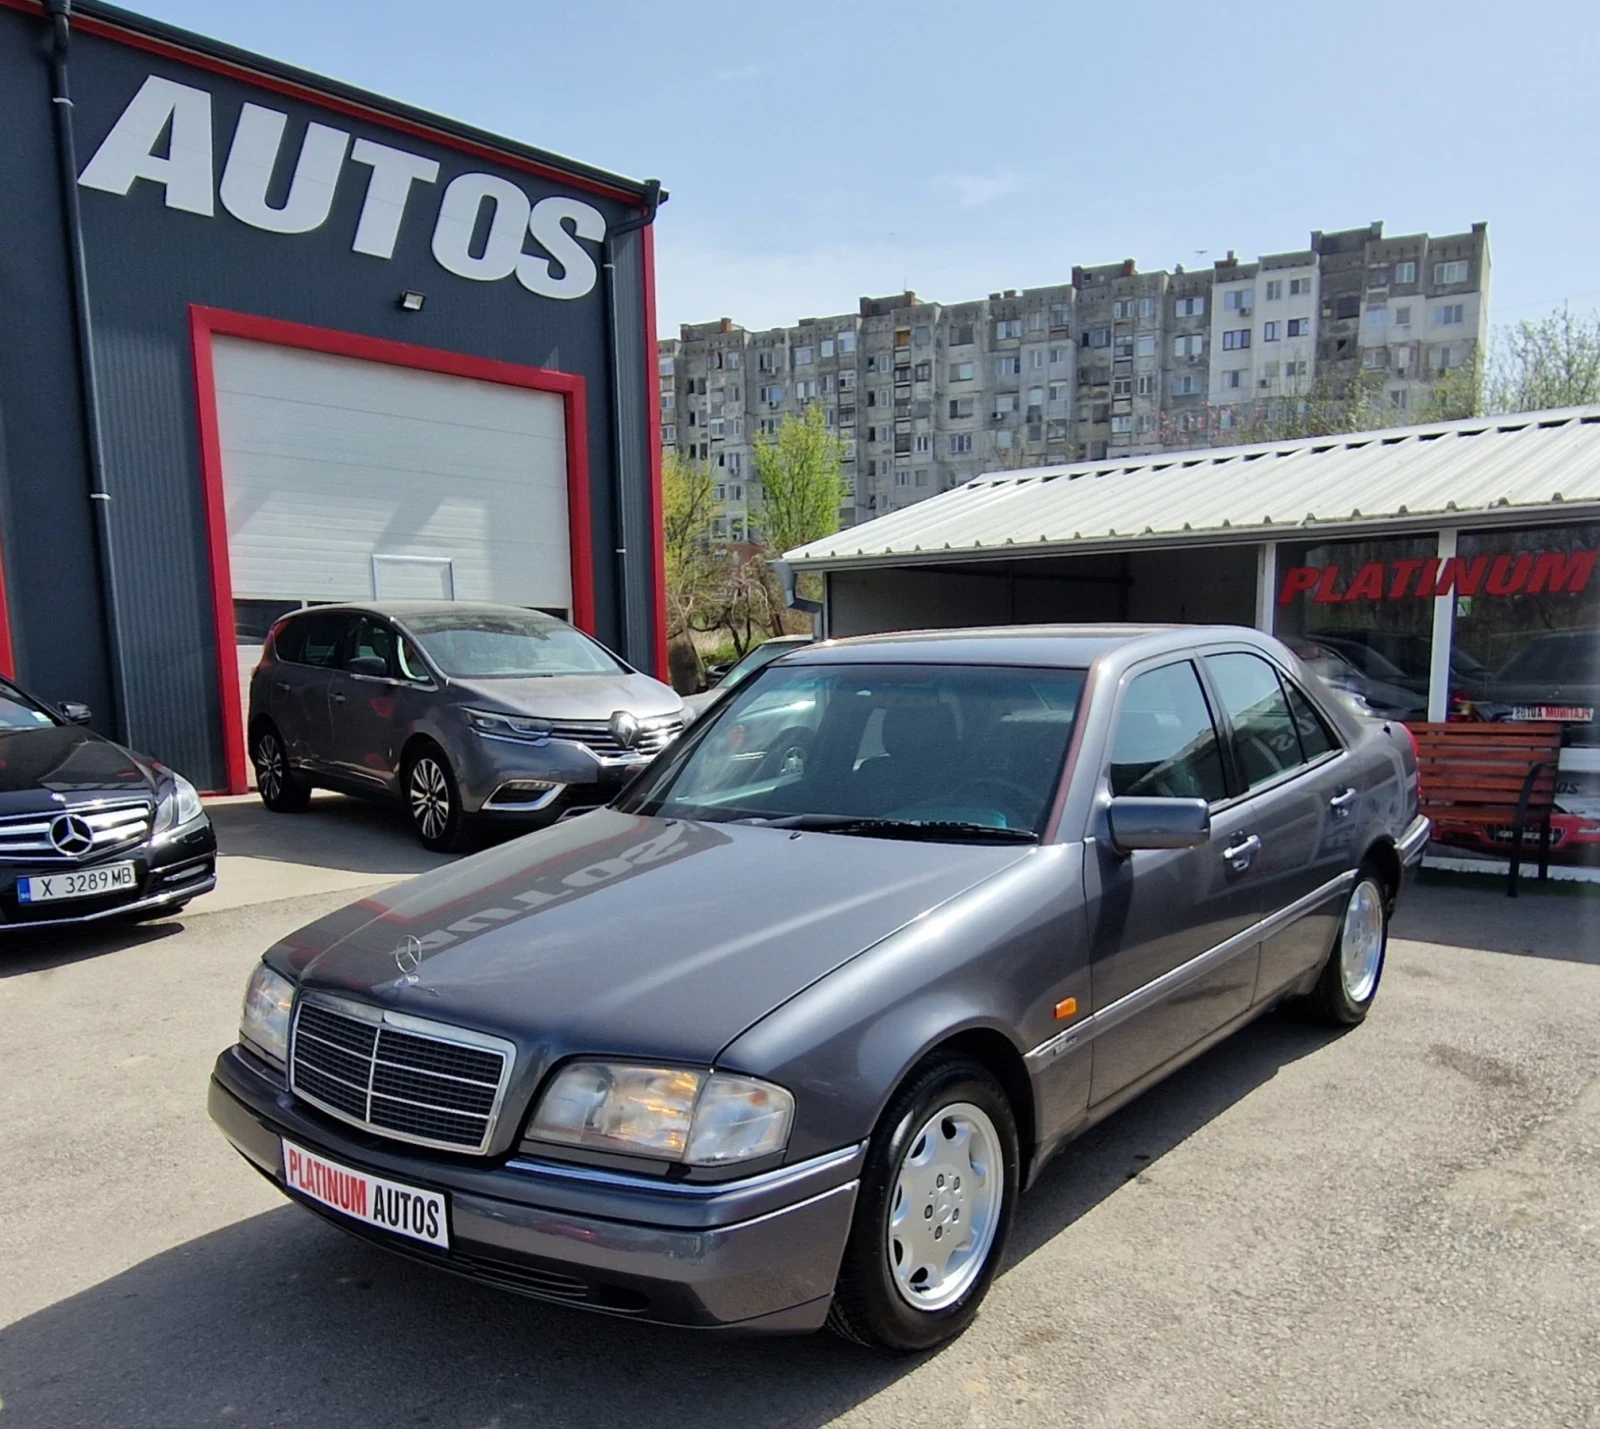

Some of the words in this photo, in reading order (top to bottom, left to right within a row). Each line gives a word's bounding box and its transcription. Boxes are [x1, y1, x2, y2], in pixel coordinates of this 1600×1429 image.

[77, 74, 606, 300] AUTOS
[1279, 549, 1599, 606] PLATINUM
[41, 879, 53, 897] X
[65, 871, 108, 895] 3289
[111, 867, 132, 887] MB
[289, 1148, 367, 1218] PLATINUM
[373, 1184, 440, 1240] AUTOS
